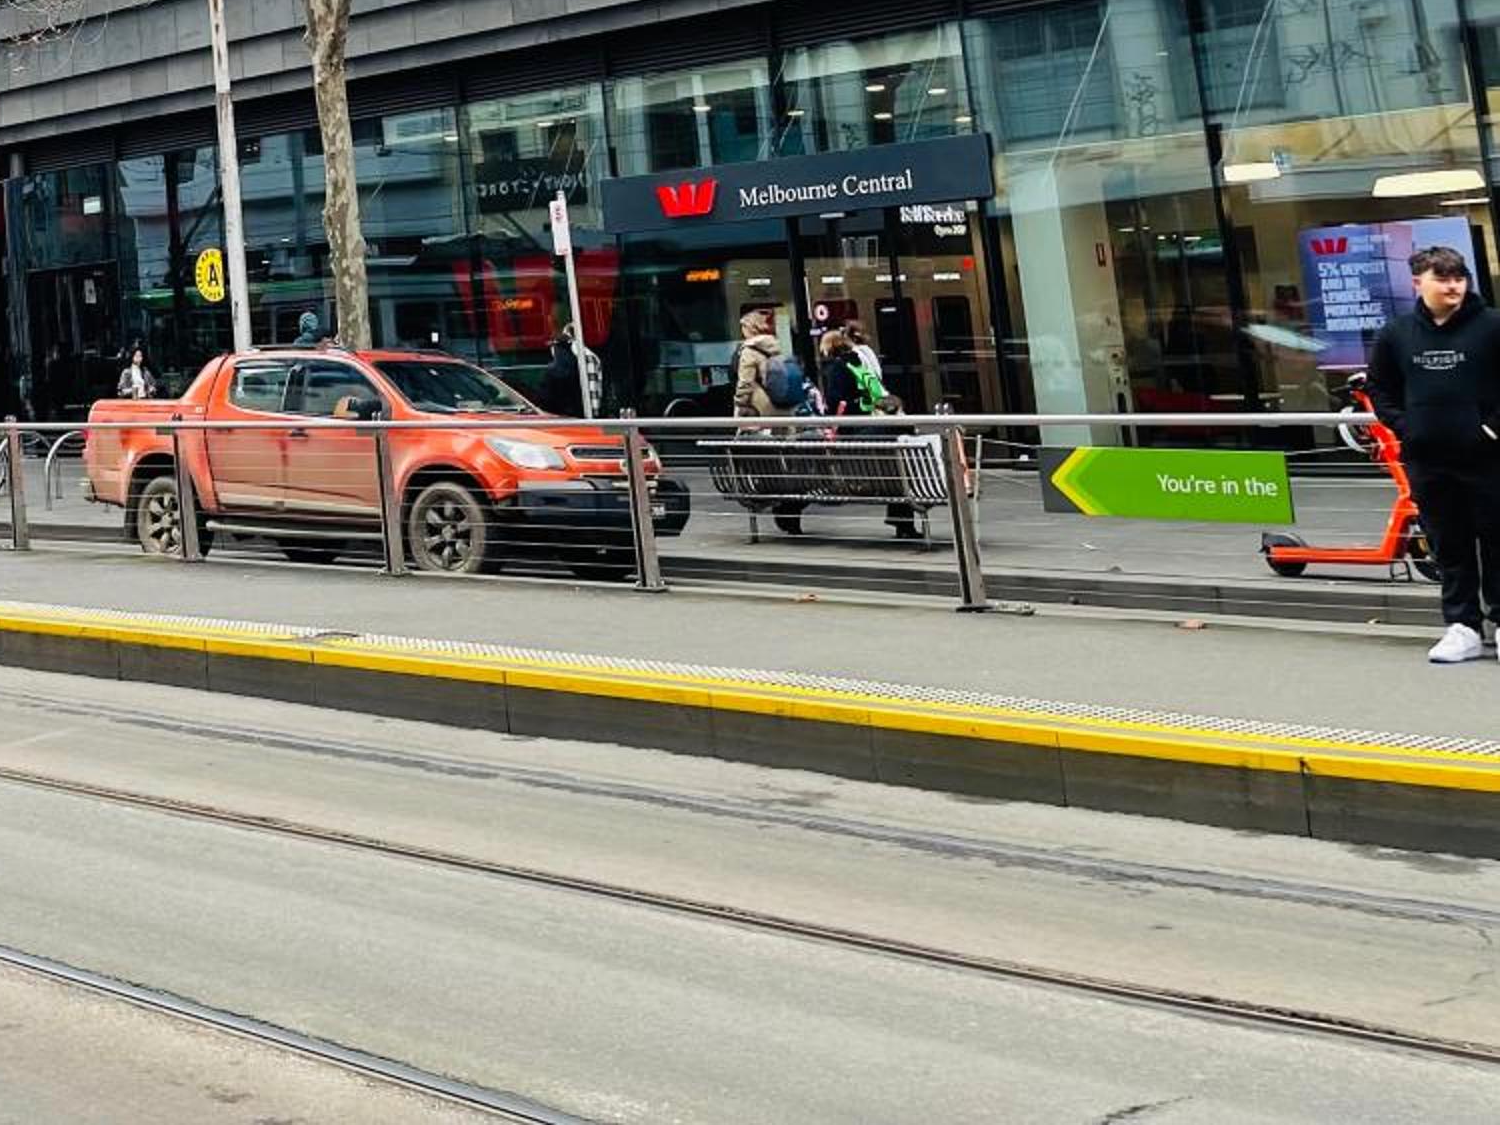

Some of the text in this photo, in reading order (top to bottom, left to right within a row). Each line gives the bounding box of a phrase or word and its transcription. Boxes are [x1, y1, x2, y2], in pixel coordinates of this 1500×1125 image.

[739, 183, 837, 208] Melbourne
[842, 168, 913, 197] Central
[1156, 474, 1279, 496] You're in the
